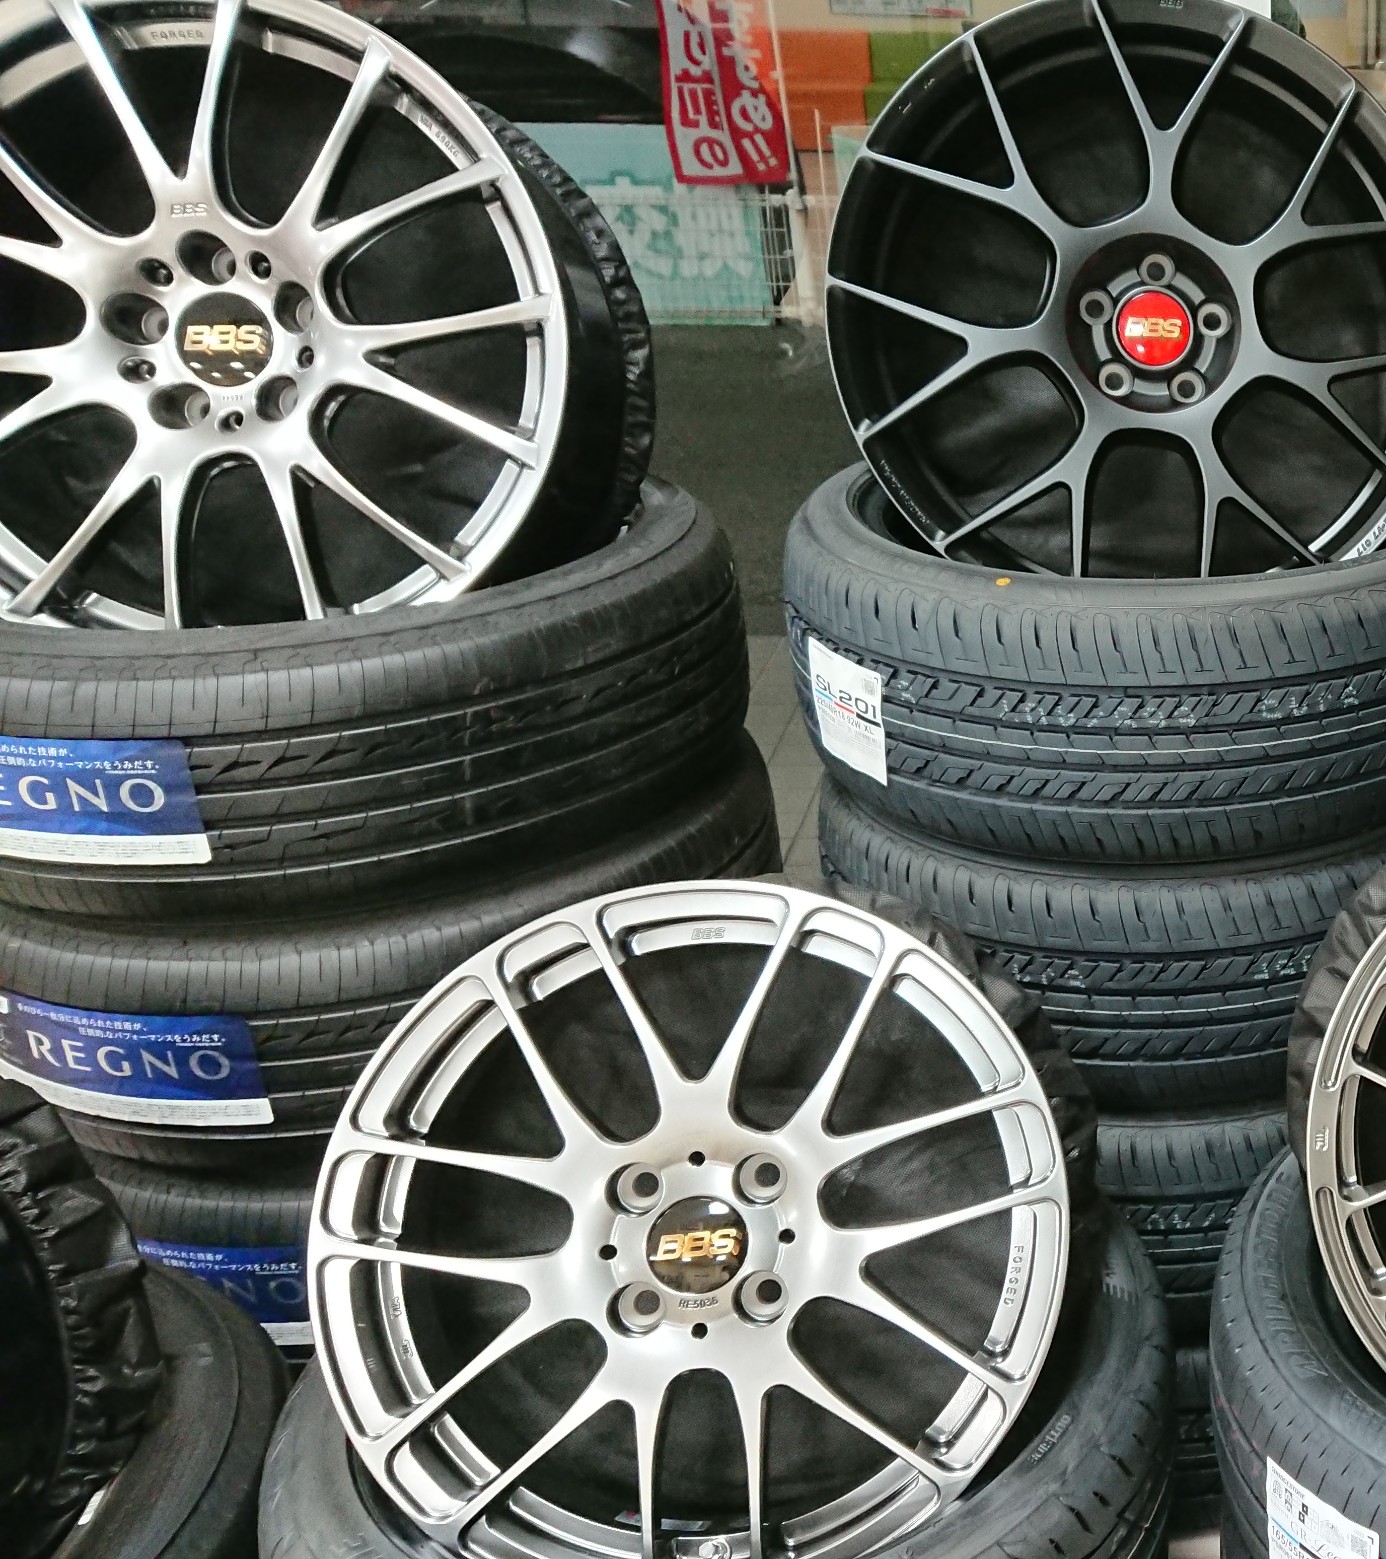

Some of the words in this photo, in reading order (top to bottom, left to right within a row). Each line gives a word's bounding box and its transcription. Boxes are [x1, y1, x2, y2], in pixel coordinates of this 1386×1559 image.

[150, 30, 204, 40] FORGED
[171, 203, 207, 217] BBS
[184, 325, 264, 351] BBS
[1125, 316, 1182, 338] BBS
[691, 926, 726, 941] BBS
[26, 1029, 231, 1080] REGNO
[656, 1228, 738, 1260] BBS
[1004, 1245, 1024, 1306] FORGED
